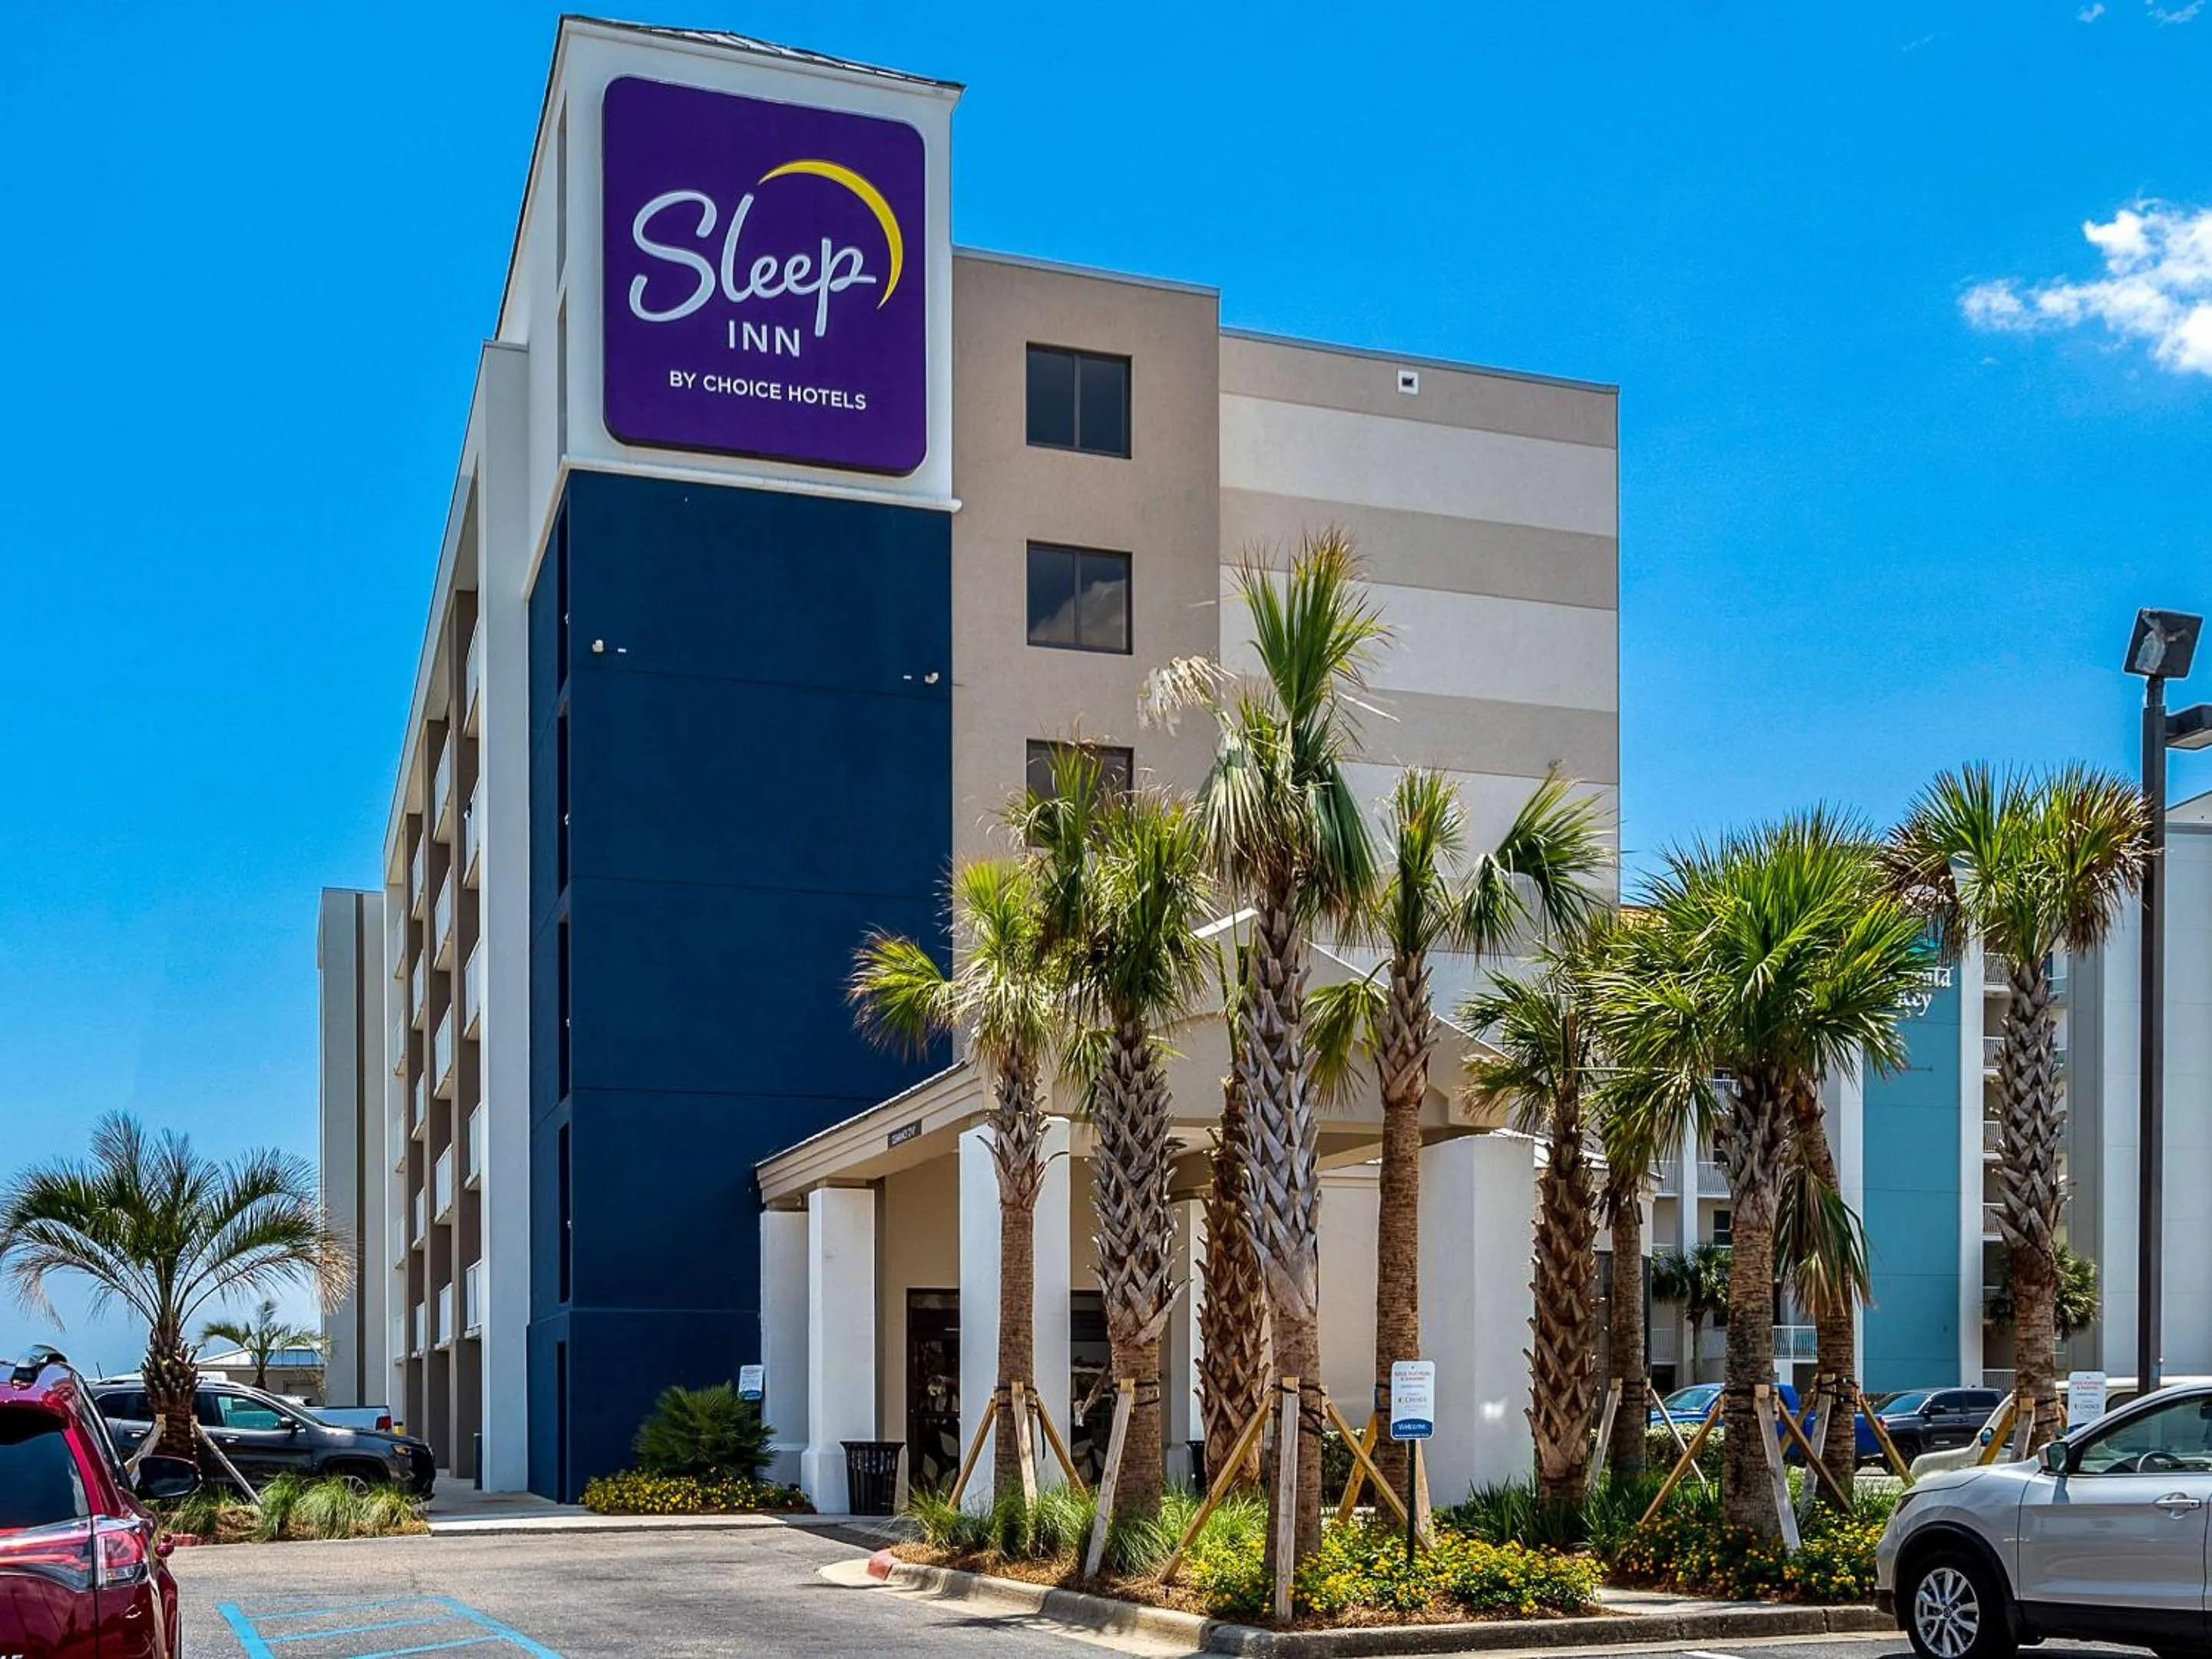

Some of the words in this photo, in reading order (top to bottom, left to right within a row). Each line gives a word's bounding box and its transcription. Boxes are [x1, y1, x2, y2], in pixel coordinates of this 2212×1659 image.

[628, 190, 877, 337] Sleep
[728, 320, 800, 357] INN
[670, 369, 697, 389] BY
[703, 375, 782, 400] CHOICE
[788, 385, 866, 410] HOTELS
